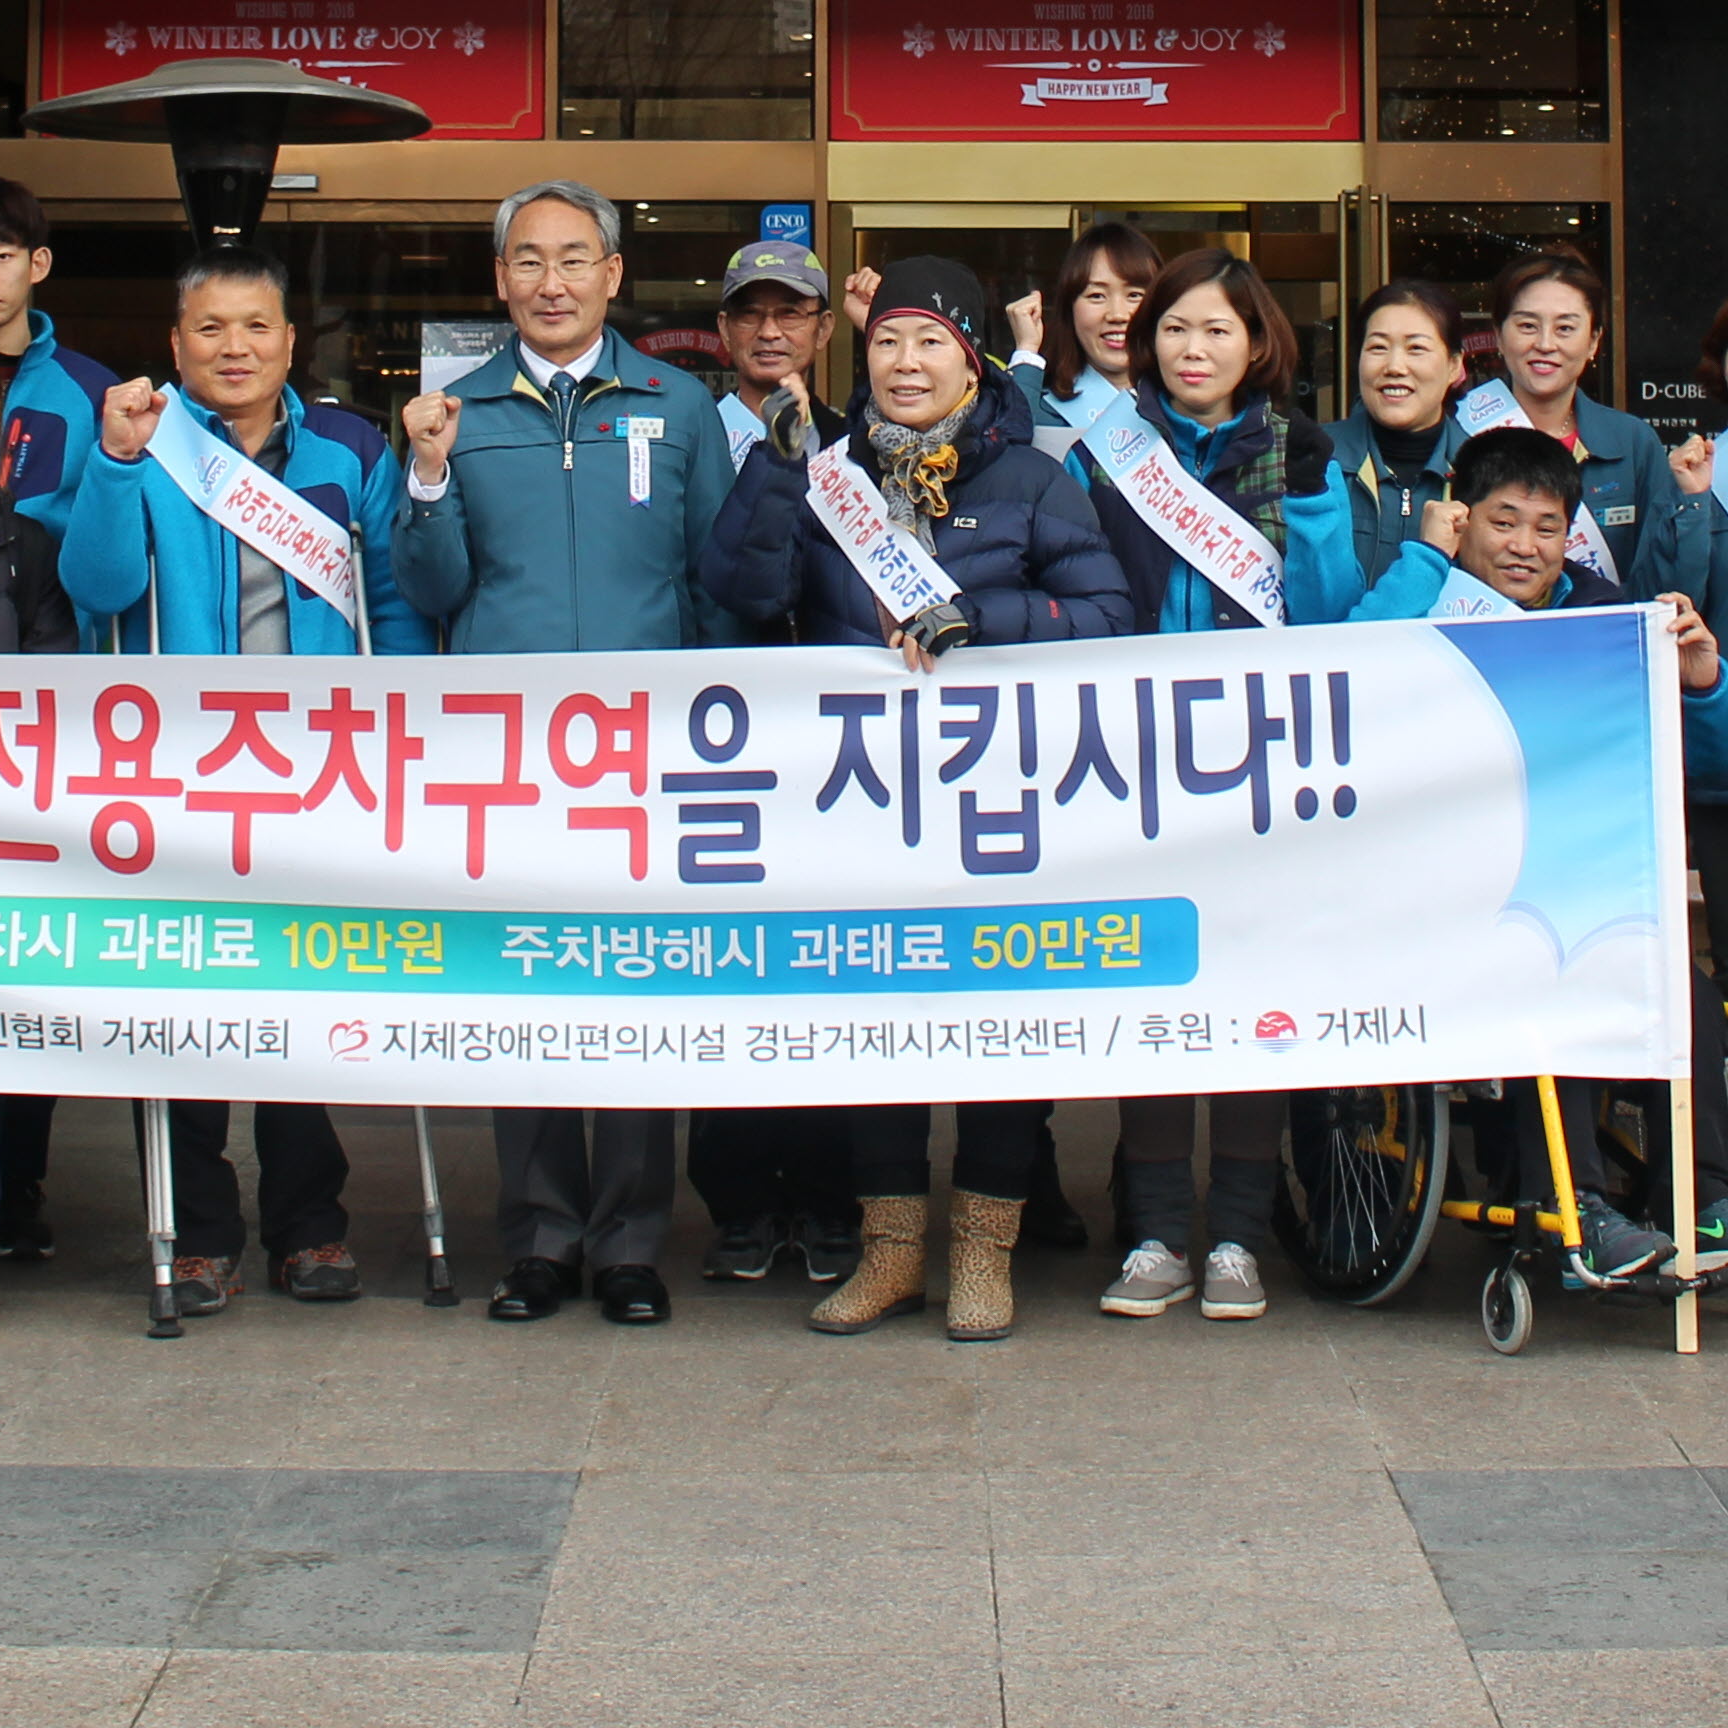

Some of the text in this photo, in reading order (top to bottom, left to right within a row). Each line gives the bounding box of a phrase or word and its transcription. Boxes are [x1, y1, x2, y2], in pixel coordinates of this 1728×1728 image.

[234, 1, 355, 19] WISHING YOU 2016
[1033, 3, 1155, 21] WISHING YOU 2016
[147, 26, 442, 51] WINTER LOVE & JOY
[945, 27, 1244, 52] WINTER LOVE & JOY
[1047, 82, 1141, 97] HAPPY NEW YEAR
[1130, 453, 1263, 581] 장애인전용주차구역
[815, 671, 1359, 877] 지킵시다!!
[99, 911, 260, 971] 과태료
[281, 920, 445, 975] 10만원
[500, 924, 765, 978] 주차방해시
[789, 923, 951, 976] 과태료
[970, 913, 1142, 971] 50만원
[101, 1016, 291, 1062] 거제시지회
[381, 1019, 727, 1063] 지체장애인편의시설
[744, 1016, 1087, 1063] 경남거제시지원센터
[1137, 1011, 1213, 1053] 후원
[1315, 1004, 1427, 1046] 거제시
